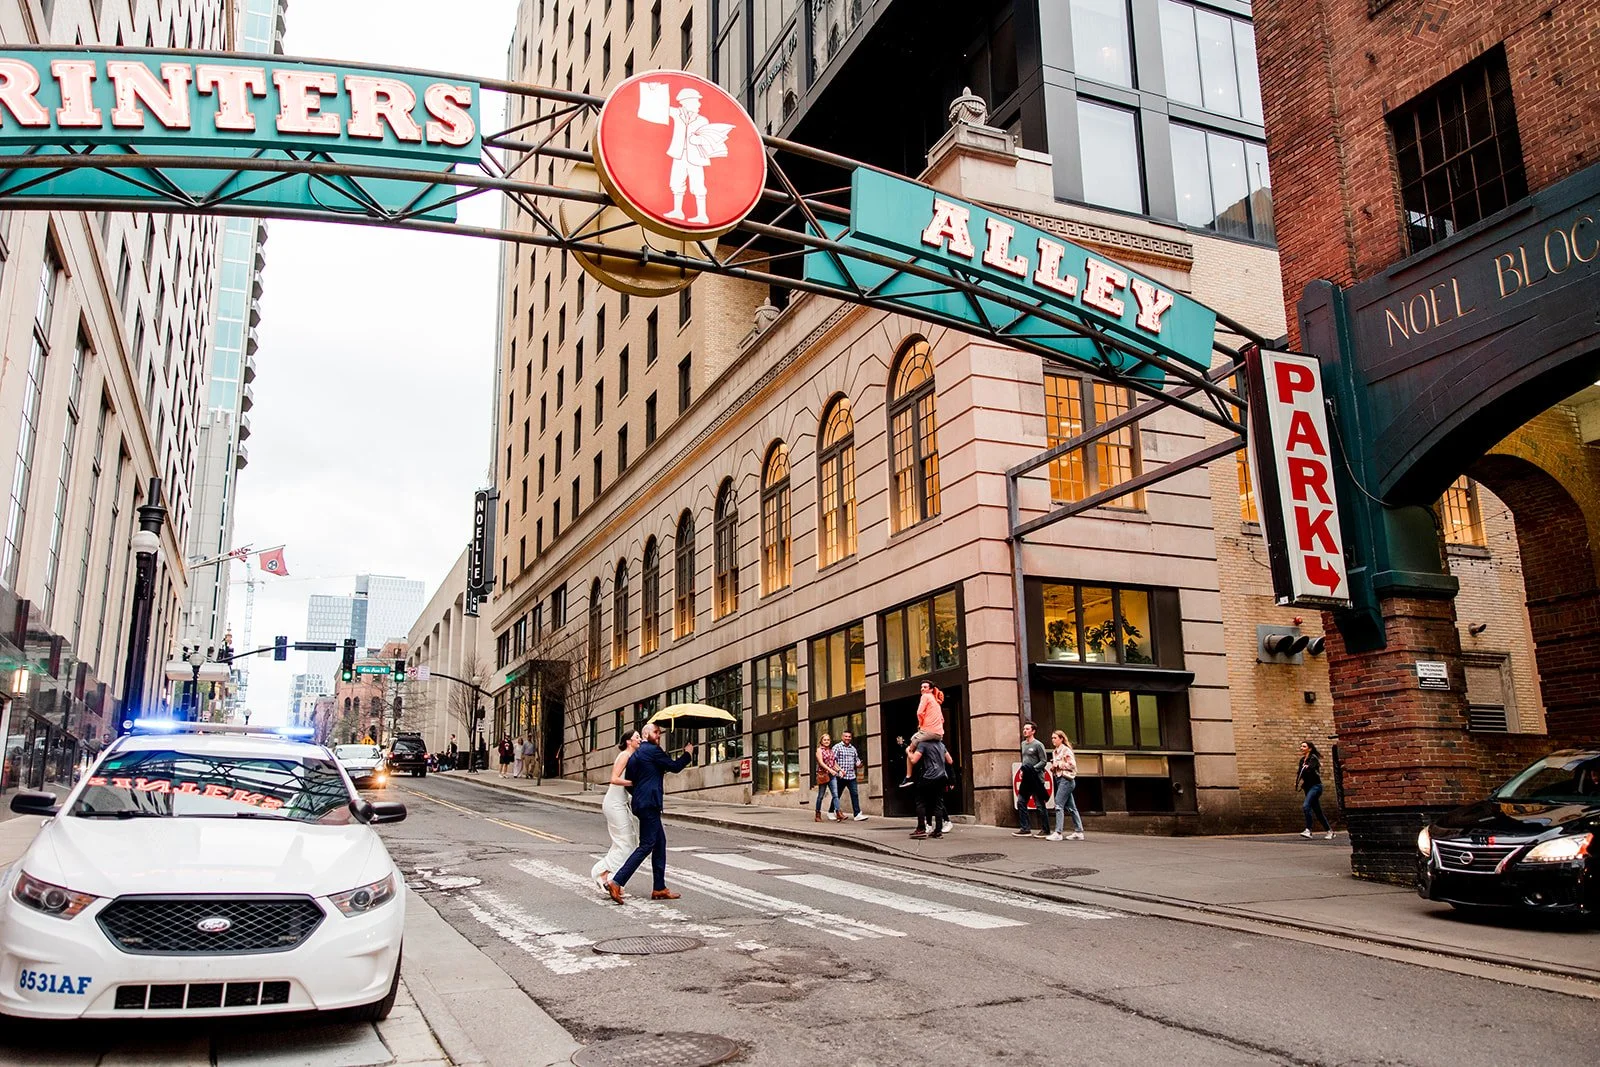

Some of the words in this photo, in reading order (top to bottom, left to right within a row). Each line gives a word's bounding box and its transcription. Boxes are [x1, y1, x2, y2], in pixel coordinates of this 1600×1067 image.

[0, 57, 476, 147] RINTERS
[921, 198, 1175, 334] ALLEY
[1385, 277, 1476, 348] NOEL
[1274, 361, 1340, 555] PARK
[474, 500, 484, 579] NOELLE
[19, 969, 92, 995] 8531AF
